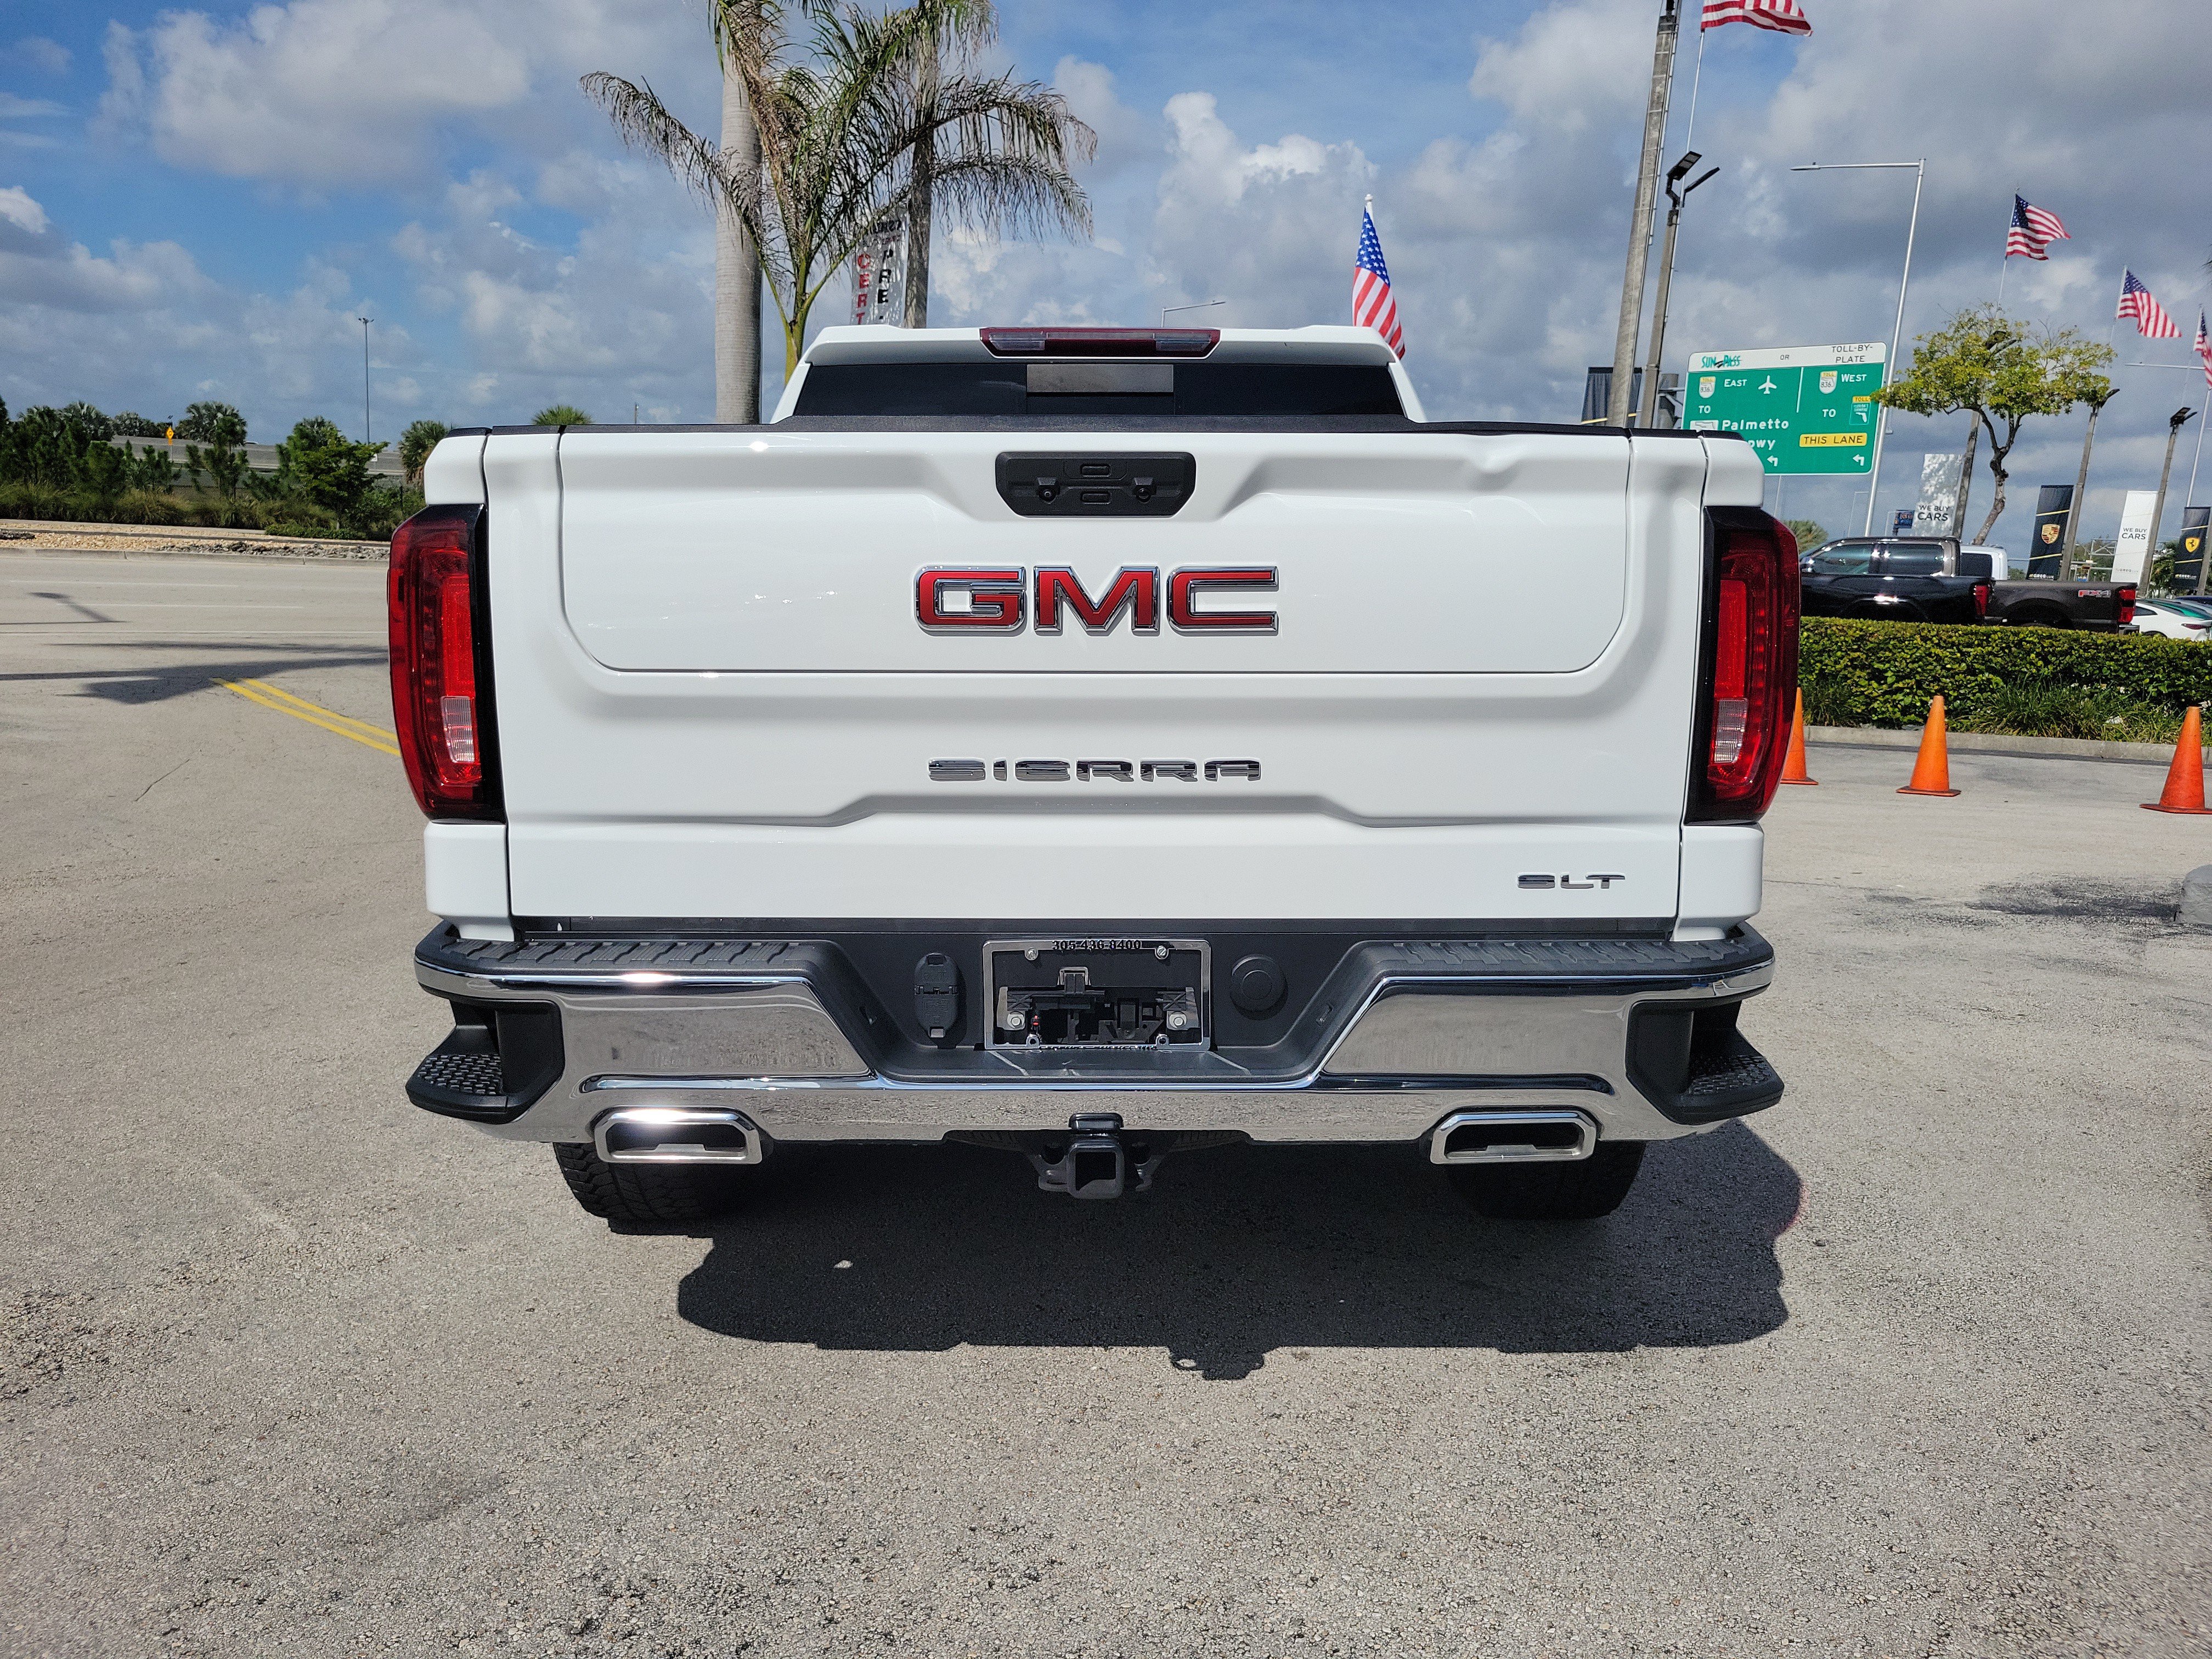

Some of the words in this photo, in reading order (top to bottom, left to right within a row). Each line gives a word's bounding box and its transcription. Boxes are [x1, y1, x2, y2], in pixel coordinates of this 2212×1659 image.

[1841, 374, 1867, 382] WEST
[1699, 405, 1711, 414] TO
[1822, 409, 1836, 417] TO
[1722, 419, 1789, 430] Palmetto
[1804, 436, 1827, 444] THIS
[1833, 436, 1863, 444] LANE
[1918, 512, 1949, 521] CARS
[915, 565, 1279, 632] GMC
[928, 758, 1261, 782] SIERRA
[1517, 874, 1626, 889] SLT
[1052, 940, 1142, 950] 305-436-8400
